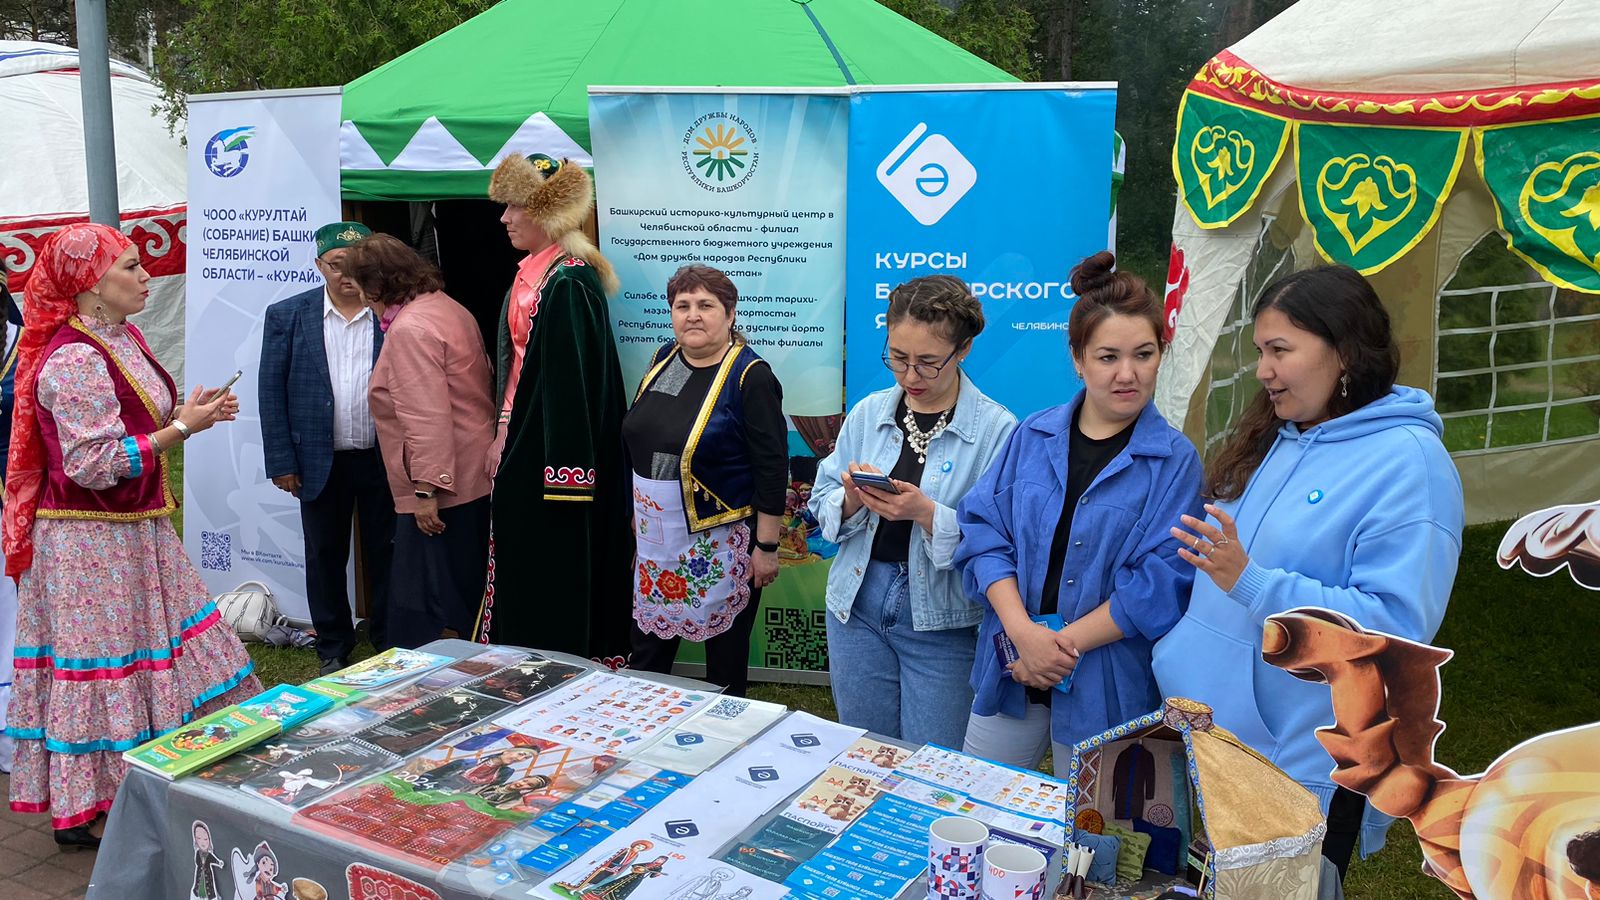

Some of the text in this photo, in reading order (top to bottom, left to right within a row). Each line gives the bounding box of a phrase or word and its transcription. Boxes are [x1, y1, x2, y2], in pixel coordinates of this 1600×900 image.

[683, 112, 758, 144] ДОМ ДРУЖБЫ НАРОДОВ
[682, 152, 759, 193] РЕСПУБЛИКИ БАШКОРТОСТАН
[204, 207, 306, 221] ЧООО «КУРУЛТАЙ
[610, 208, 667, 218] Башкирский
[670, 209, 788, 219] историко-культурный
[792, 212, 826, 220] центр
[202, 227, 317, 242] (СОБРАНИЕ) БАШКИ
[640, 223, 705, 231] Челябинской
[708, 224, 752, 232] области
[760, 224, 798, 234] филиал
[611, 237, 832, 250] Государственного бюджетного учреждения
[202, 248, 290, 262] ЧЕЛЯБИНСКОЙ
[633, 253, 806, 264] «Дом дружбы народов Республики
[876, 252, 967, 269] КУРСЫ
[202, 268, 255, 280] ОБЛАСТИ
[266, 268, 321, 283] «КУРАЙ»
[624, 292, 658, 300] Силәбе
[876, 282, 1076, 299] БРСКОГО
[775, 296, 818, 304] тарихи-
[792, 324, 824, 333] йорто
[1012, 322, 1069, 330] ЧЕЛЯБИНС
[778, 338, 823, 347] филиалы
[393, 770, 439, 789] 2024
